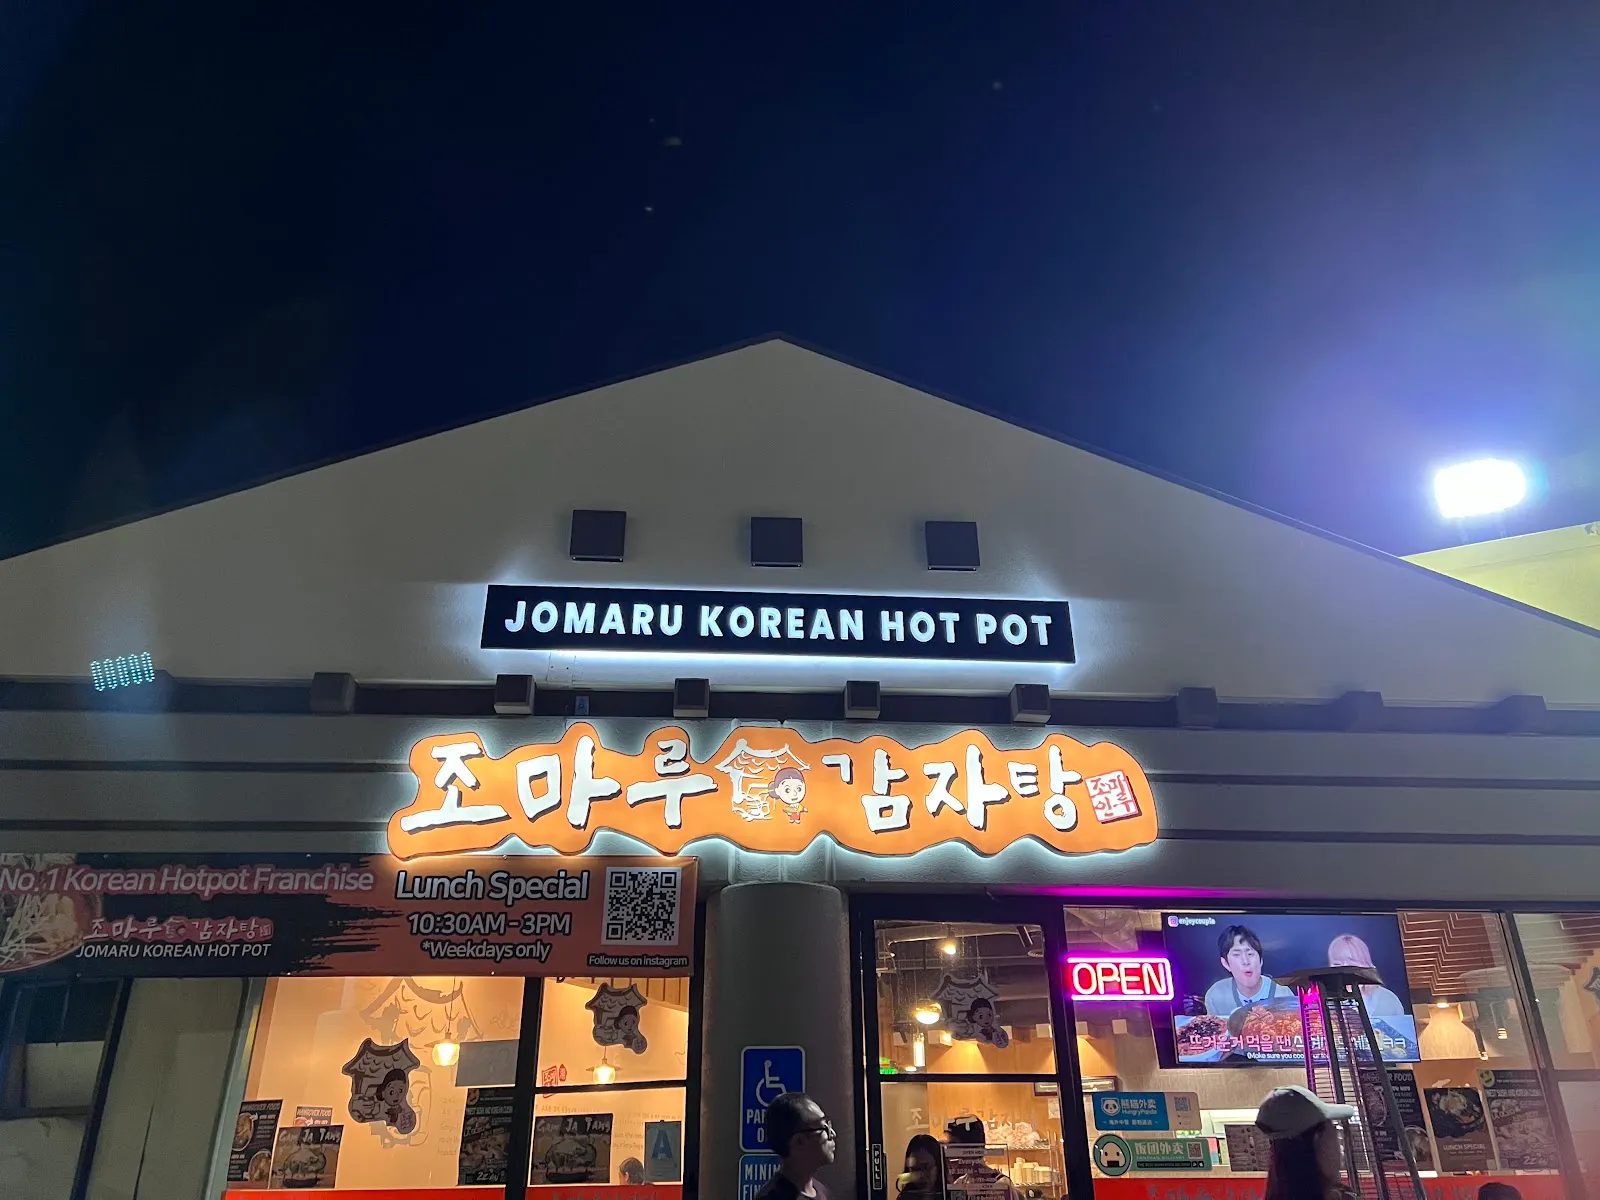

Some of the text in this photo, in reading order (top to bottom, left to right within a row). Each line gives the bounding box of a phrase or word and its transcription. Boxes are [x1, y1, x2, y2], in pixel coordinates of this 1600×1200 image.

[504, 601, 1053, 646] JOMARU KOREAN HOT POT
[400, 735, 1083, 834] 조마루 감자탕
[64, 867, 156, 891] Korean
[160, 867, 250, 896] Hotpot
[254, 866, 374, 892] Franchise
[397, 870, 588, 905] Lunch Special
[76, 944, 271, 958] JOMARU KOREAN HOT POT
[515, 941, 552, 961] only
[588, 955, 618, 966] Follow
[618, 958, 630, 966] us
[630, 958, 644, 967] on
[1072, 962, 1167, 995] OPEN
[1246, 1034, 1274, 1052] 먹을
